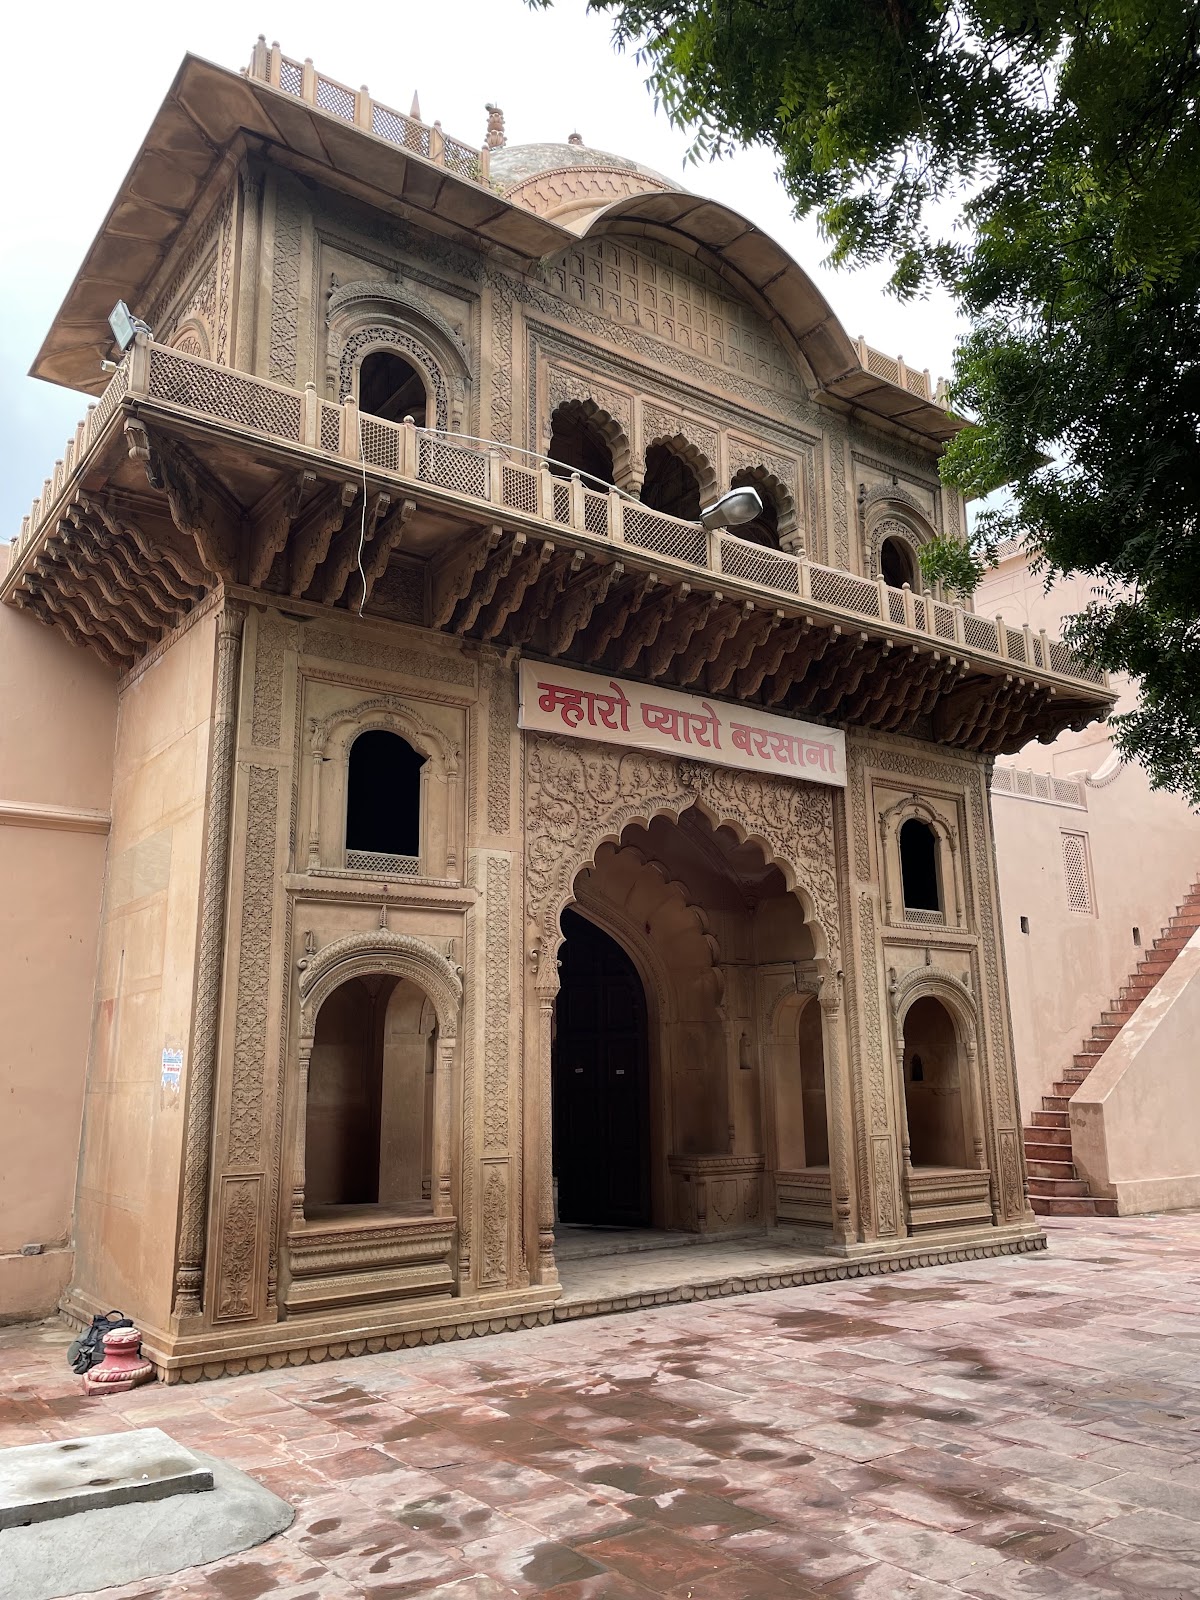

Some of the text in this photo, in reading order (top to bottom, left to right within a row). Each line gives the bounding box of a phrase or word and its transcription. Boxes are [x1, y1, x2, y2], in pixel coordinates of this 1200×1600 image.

[538, 681, 837, 774] म्हारो प्यारो बरसाना
